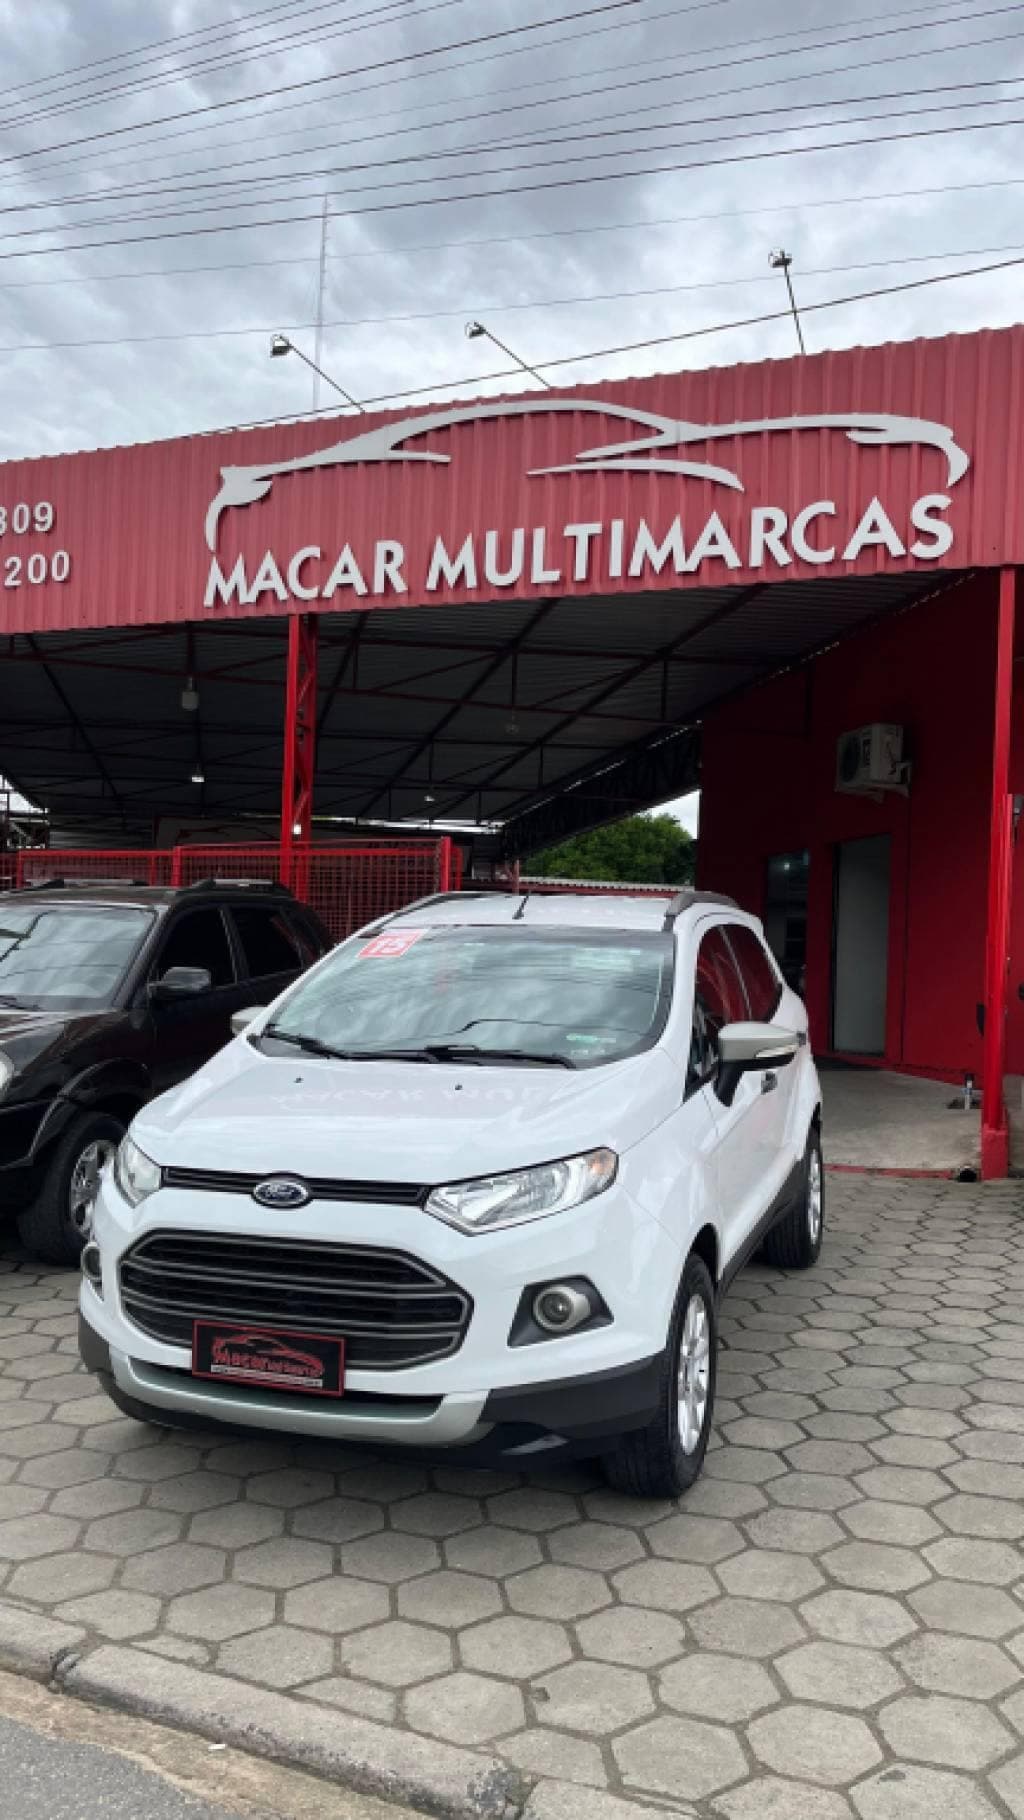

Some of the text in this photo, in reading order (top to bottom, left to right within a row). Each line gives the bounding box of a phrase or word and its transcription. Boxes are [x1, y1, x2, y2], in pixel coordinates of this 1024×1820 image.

[4, 550, 70, 587] 200
[203, 493, 954, 608] MACAR MULTIMARCAS
